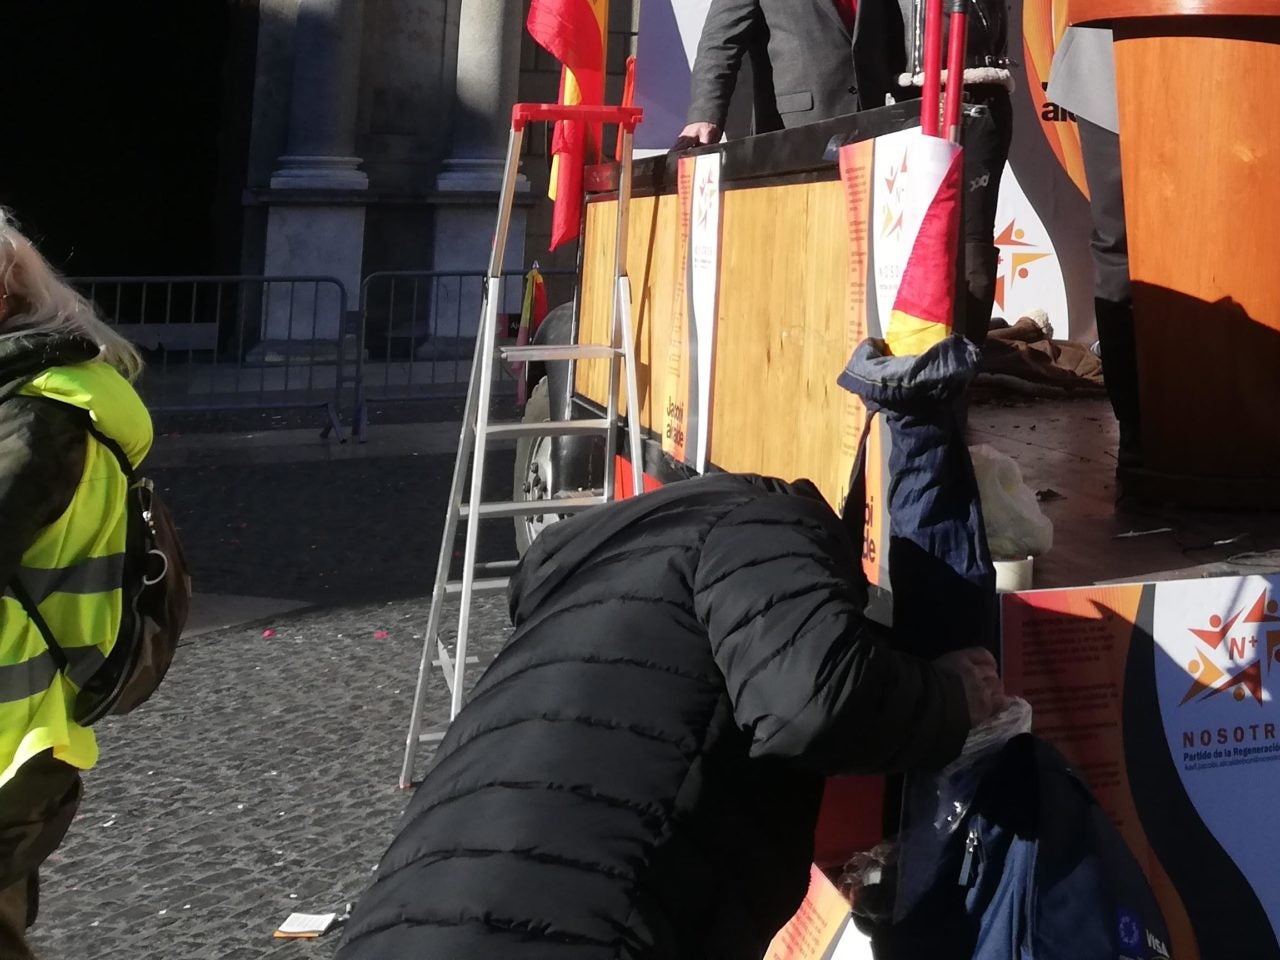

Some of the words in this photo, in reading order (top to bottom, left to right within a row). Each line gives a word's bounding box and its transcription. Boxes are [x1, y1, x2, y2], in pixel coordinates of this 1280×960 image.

[1183, 751, 1211, 762] Partido
[1213, 749, 1223, 758] de
[1224, 748, 1232, 757] la
[1145, 928, 1170, 959] VISA
